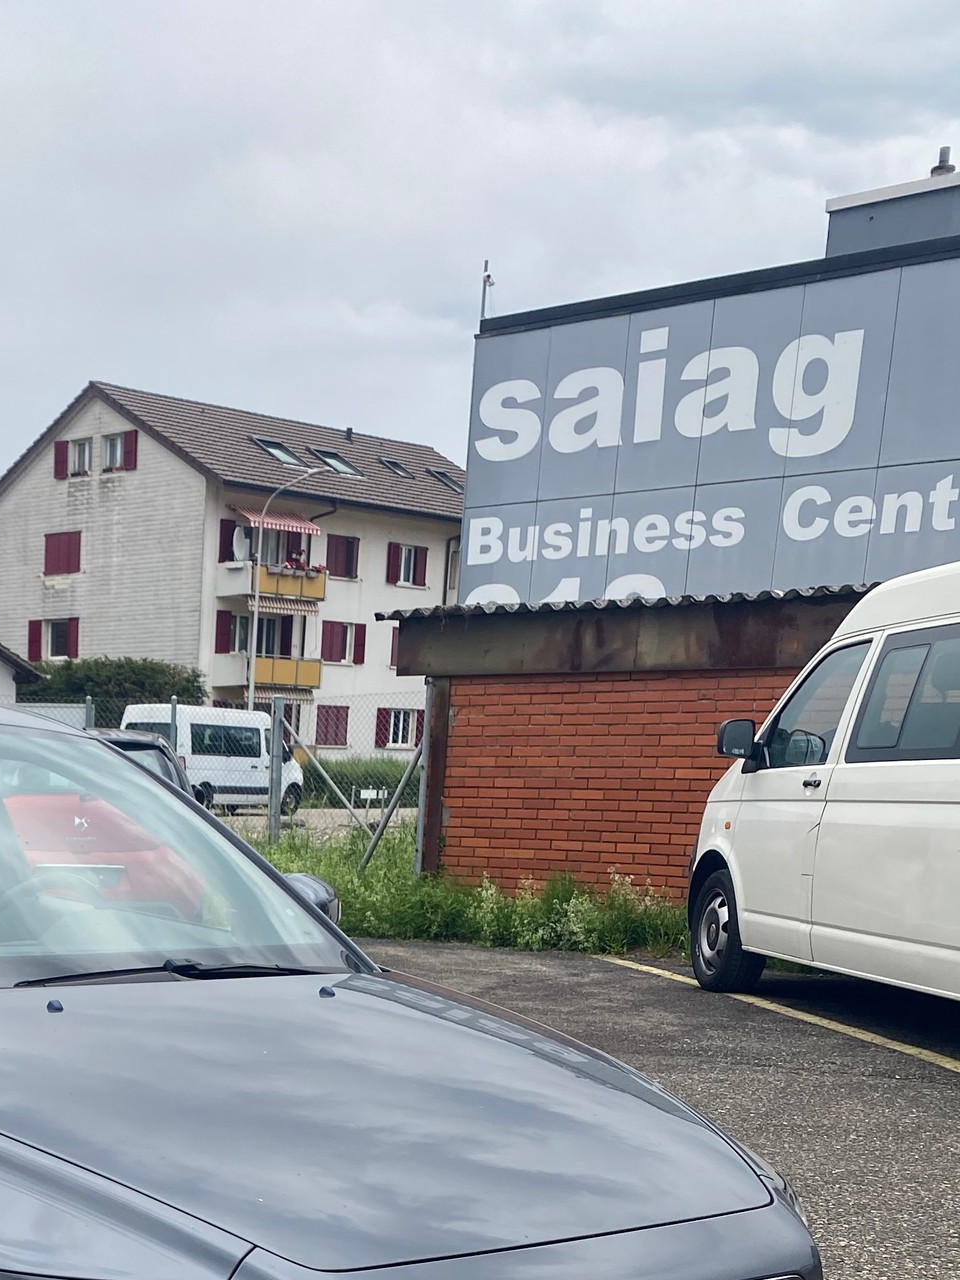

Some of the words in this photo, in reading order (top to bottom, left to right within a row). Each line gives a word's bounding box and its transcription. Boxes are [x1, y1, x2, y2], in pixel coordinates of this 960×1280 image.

[474, 326, 865, 462] saiag
[466, 507, 746, 566] Business
[782, 474, 959, 542] Cent
